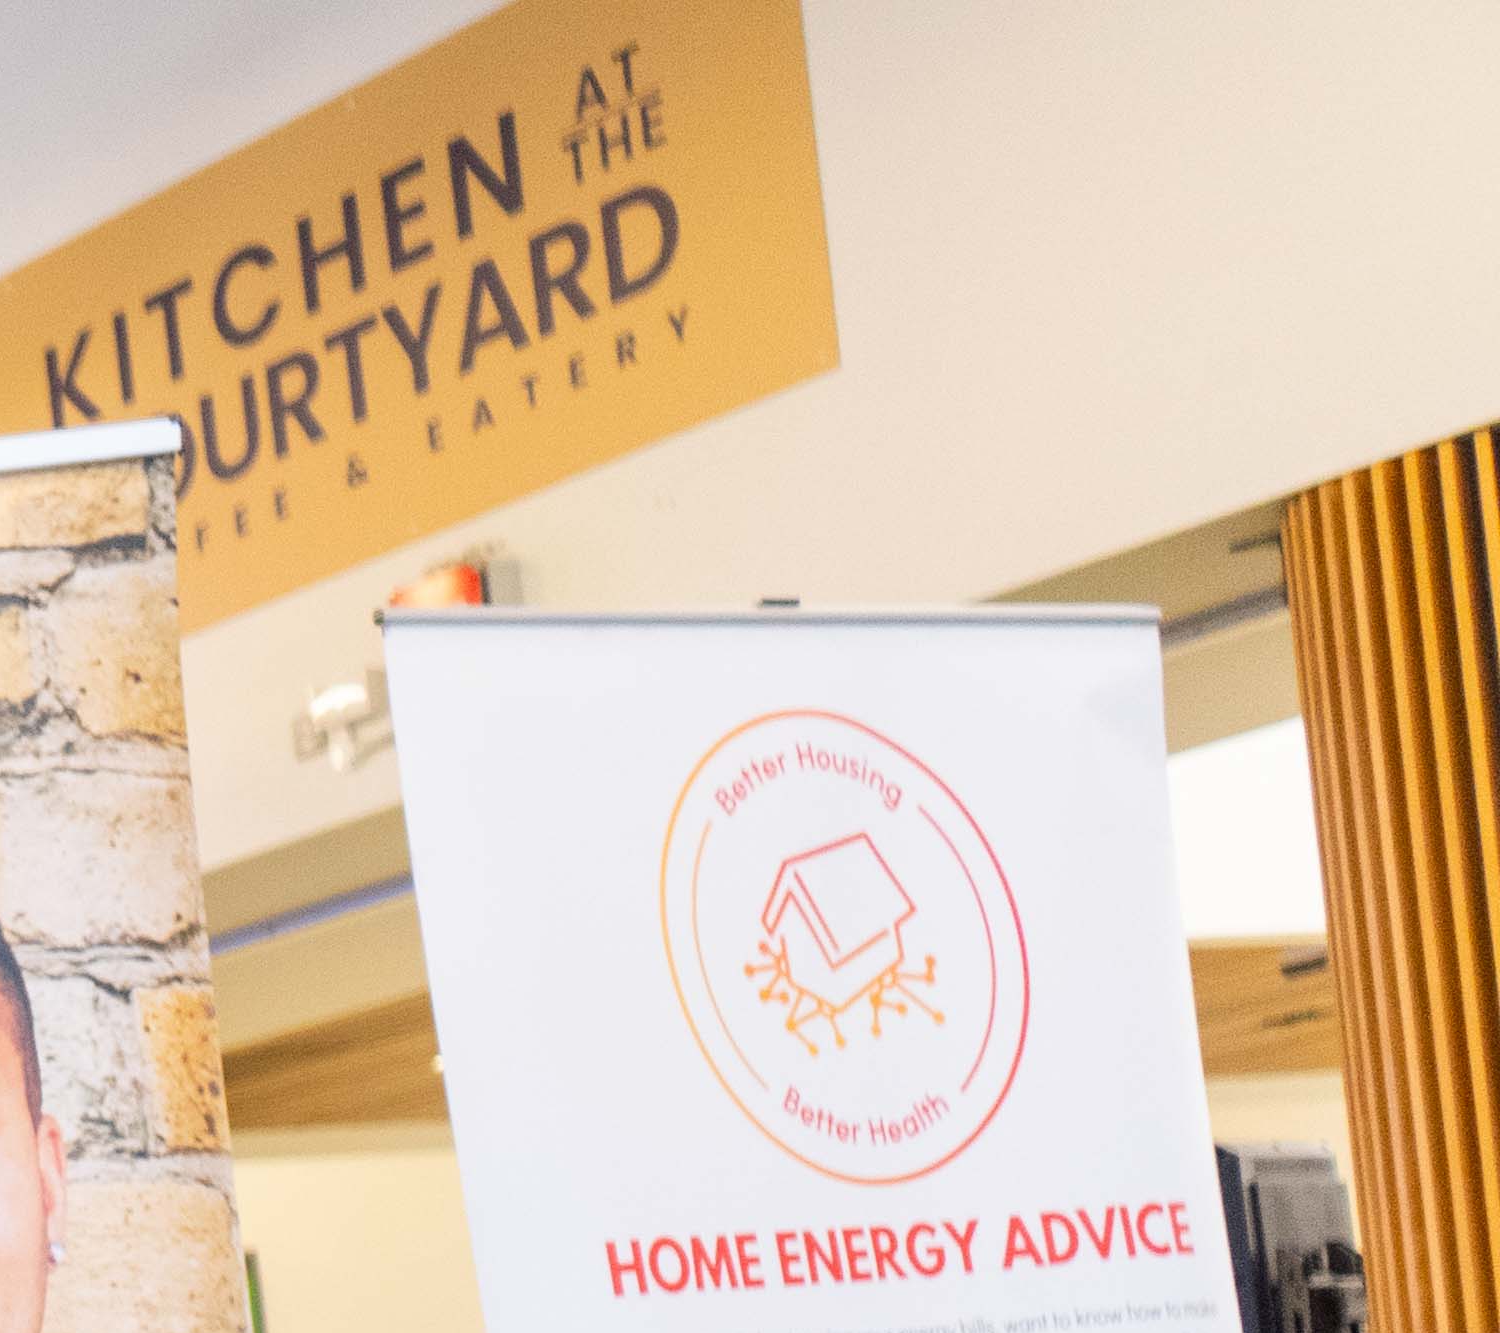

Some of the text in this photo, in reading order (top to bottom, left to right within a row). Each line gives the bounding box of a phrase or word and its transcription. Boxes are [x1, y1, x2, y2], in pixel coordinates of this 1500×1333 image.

[571, 42, 641, 118] AT
[560, 98, 667, 184] THE
[42, 108, 524, 431] KITCHEN
[178, 182, 684, 502] URTYARD
[192, 306, 689, 553] FEE & EATERY
[715, 743, 903, 817] Better Housing
[783, 1086, 950, 1148] Better Health
[605, 1201, 1194, 1298] HOME ENERGY ADVICE
